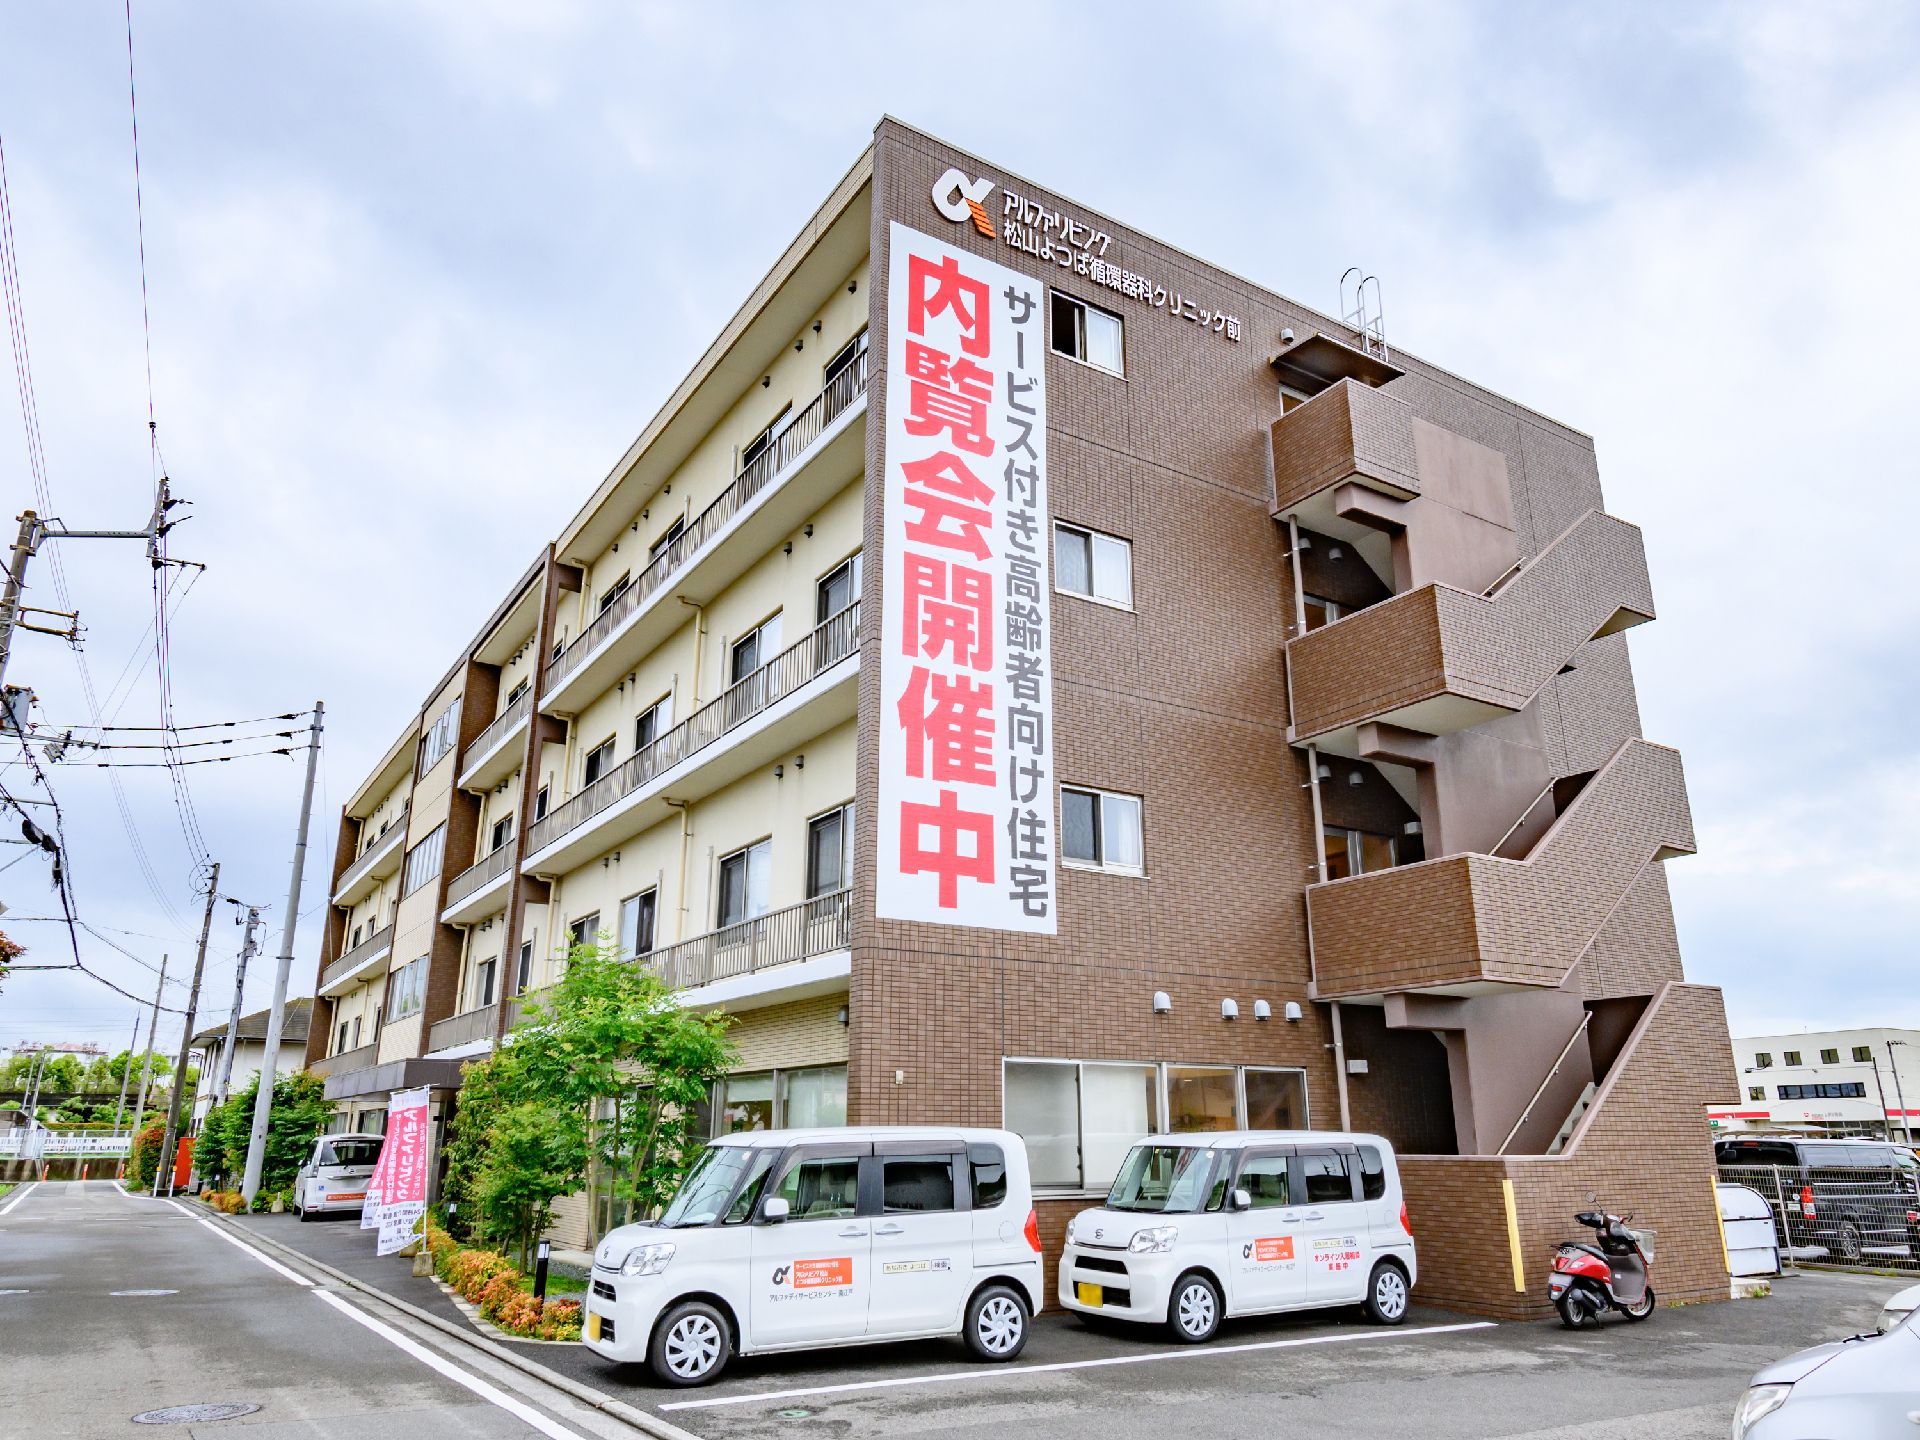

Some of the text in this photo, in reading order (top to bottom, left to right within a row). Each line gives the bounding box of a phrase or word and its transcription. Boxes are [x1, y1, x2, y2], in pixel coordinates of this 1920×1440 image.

[1003, 188, 1112, 256] アルファリビング
[1003, 219, 1241, 341] 松山よつば循環器科クリニック前
[897, 253, 996, 908] 内覧会開催中
[1003, 285, 1049, 917] サービス付き高齢者向け住宅
